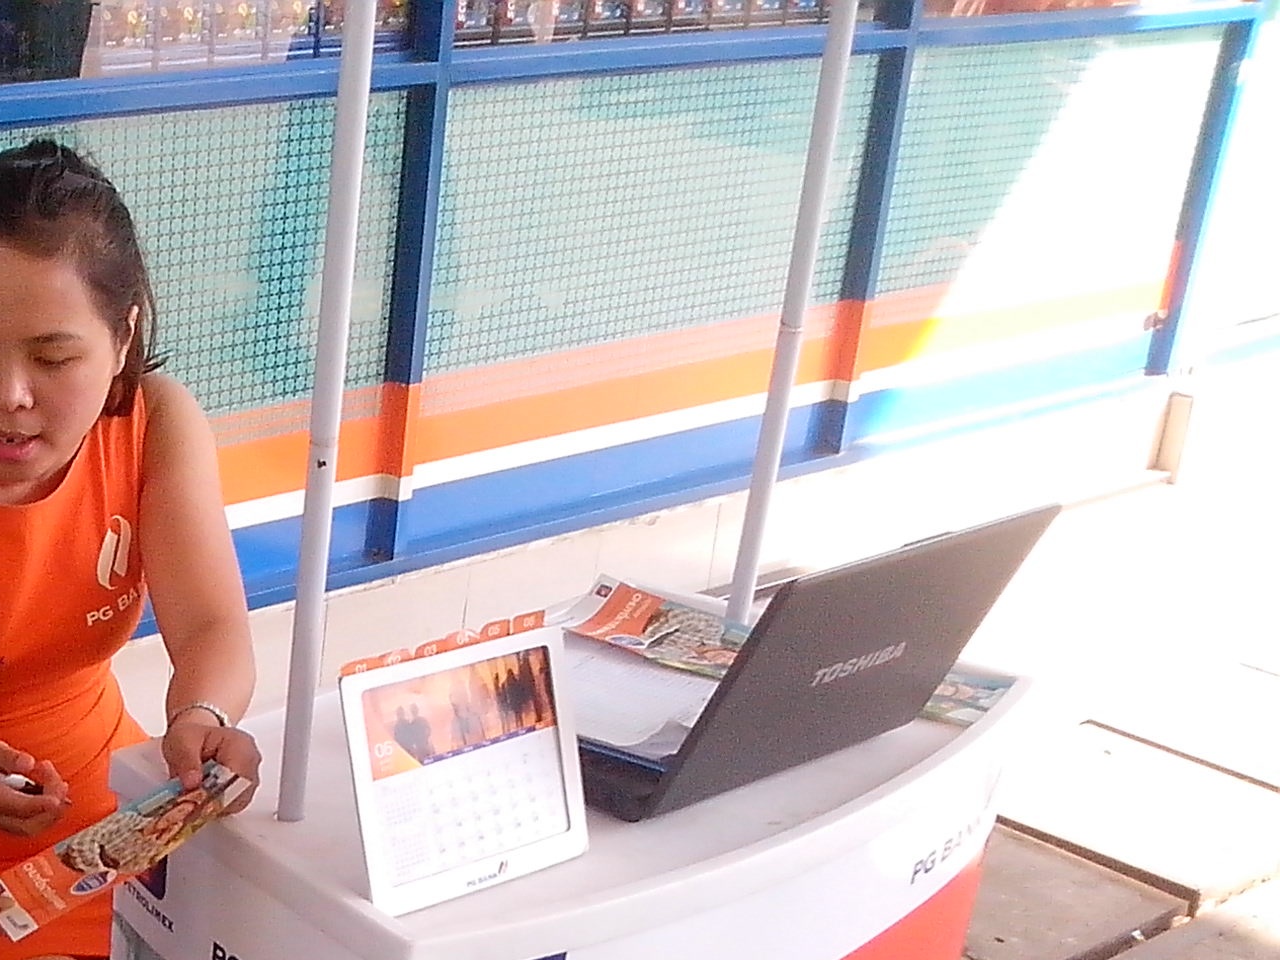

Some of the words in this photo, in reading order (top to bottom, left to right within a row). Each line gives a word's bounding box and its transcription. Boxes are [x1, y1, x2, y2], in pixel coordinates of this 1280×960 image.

[86, 605, 114, 627] PG
[811, 641, 907, 687] TOSHIBA
[910, 849, 937, 885] PG
